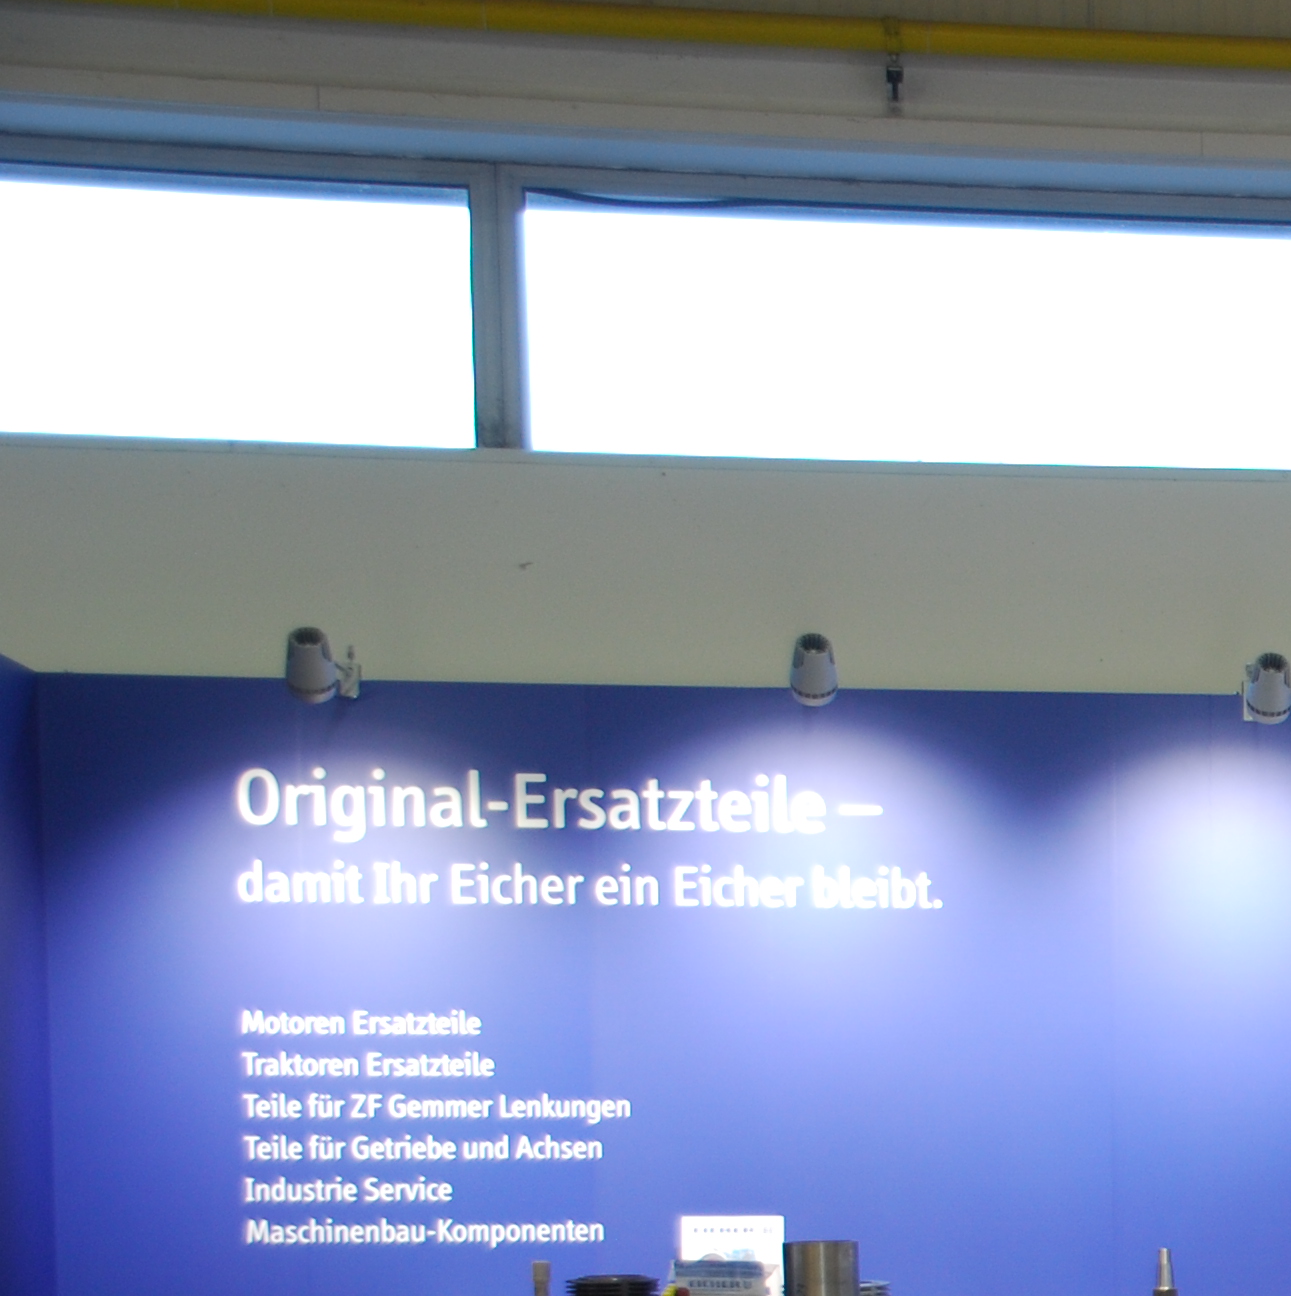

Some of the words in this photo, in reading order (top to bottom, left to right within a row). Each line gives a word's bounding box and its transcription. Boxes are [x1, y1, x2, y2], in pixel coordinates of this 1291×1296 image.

[237, 767, 827, 843] Original-Ersatzteile
[237, 859, 364, 904] damit
[372, 861, 438, 904] Ihr
[451, 863, 583, 905] Eicher
[596, 863, 660, 906] ein
[673, 865, 804, 908] Eicher
[812, 866, 944, 910] bleibt.
[241, 1010, 345, 1036] Motoren
[352, 1010, 482, 1035] Ersatzteile
[242, 1052, 359, 1078] Traktoren
[366, 1052, 495, 1078] Ersatzteile
[243, 1093, 303, 1119] Teile
[307, 1093, 345, 1119] für
[350, 1095, 383, 1119] ZF
[388, 1094, 493, 1119] Gemmer
[499, 1094, 632, 1124] Lenkungen
[243, 1135, 303, 1161] Teile
[308, 1135, 346, 1161] für
[351, 1135, 457, 1161] Getriebe
[462, 1135, 510, 1160] und
[515, 1135, 603, 1160] Achsen
[245, 1177, 358, 1203] Industrie
[363, 1177, 453, 1202] Service
[246, 1217, 605, 1249] Maschinenbau-Komponenten
